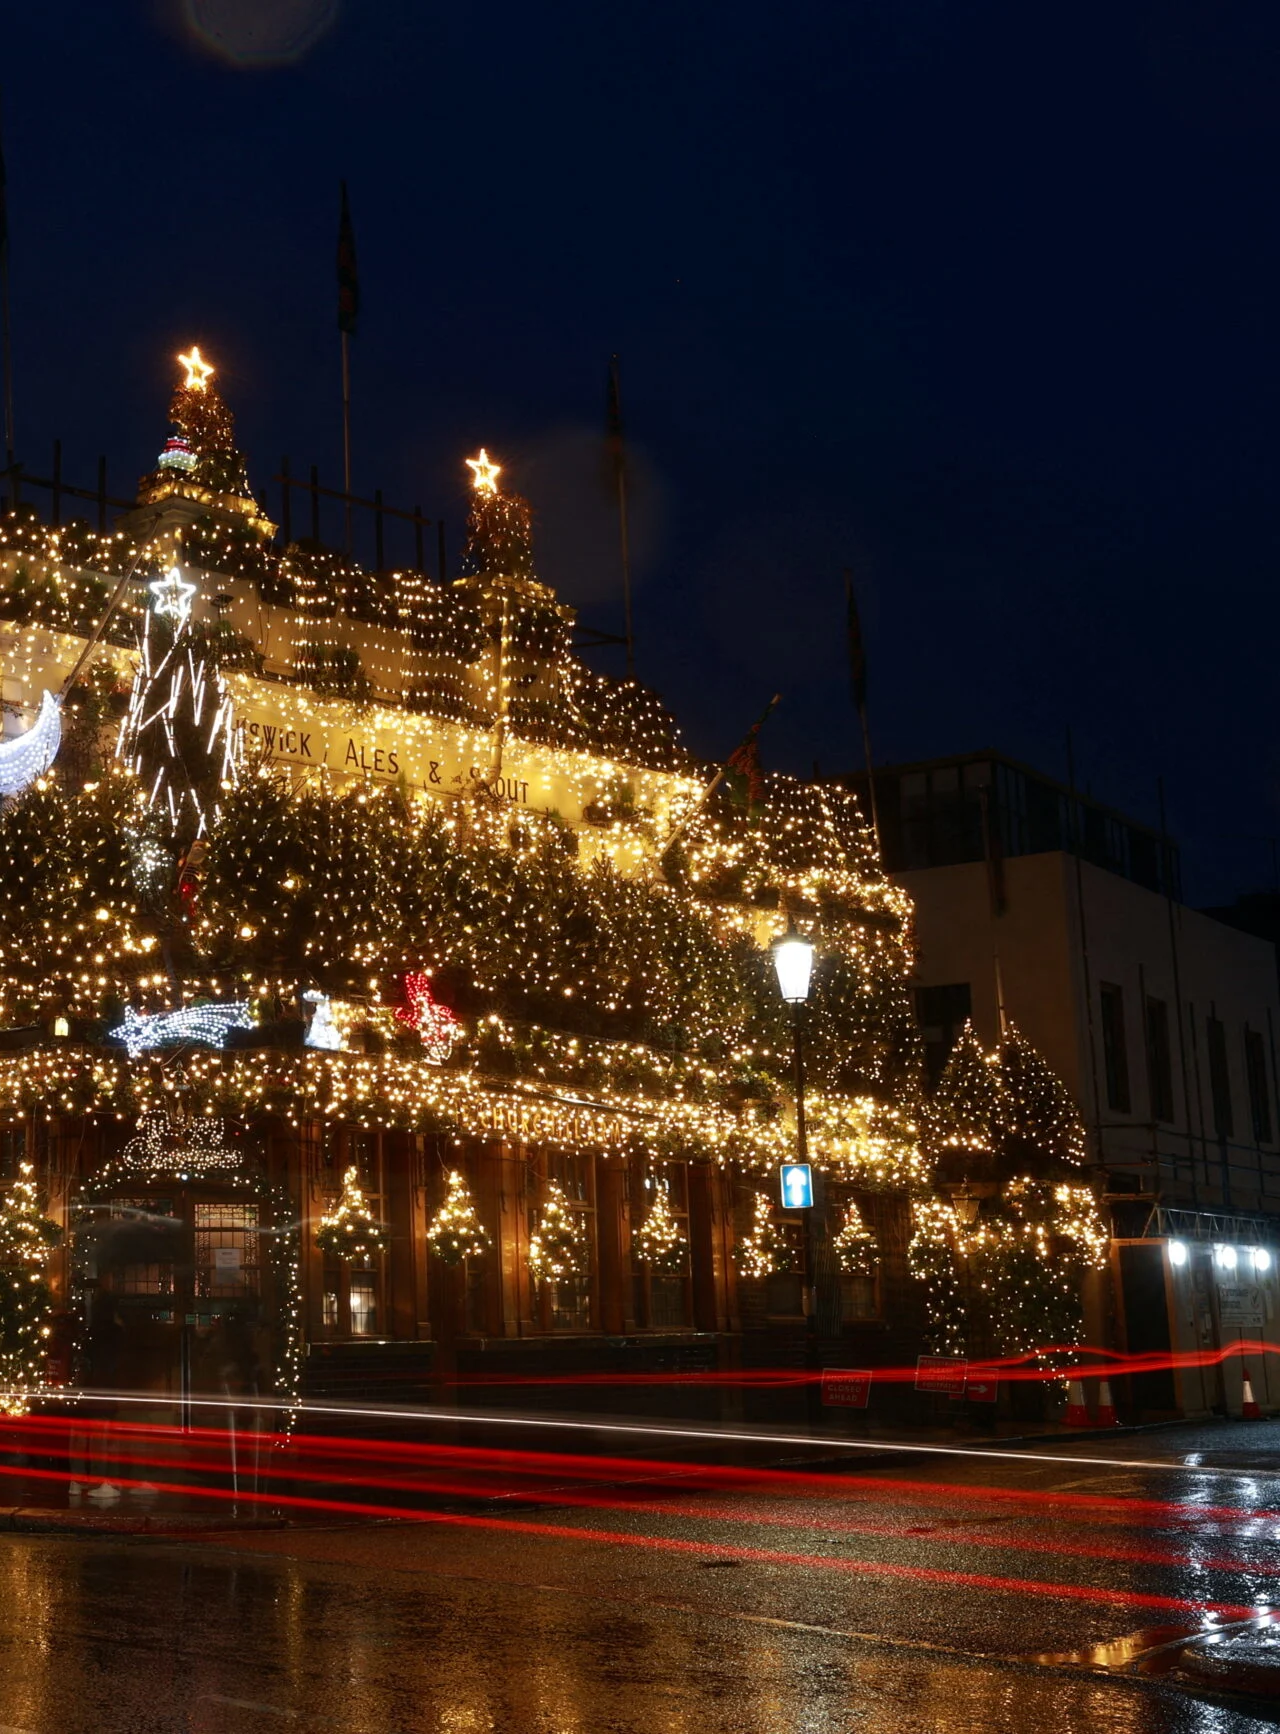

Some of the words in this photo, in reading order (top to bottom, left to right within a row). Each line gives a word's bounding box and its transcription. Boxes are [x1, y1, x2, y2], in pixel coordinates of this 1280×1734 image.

[345, 739, 399, 775] ALES
[428, 761, 442, 784] &
[470, 767, 528, 803] SOUT
[587, 1119, 622, 1143] ARM
[827, 1384, 862, 1393] CLOSED
[829, 1393, 857, 1402] AHEAD
